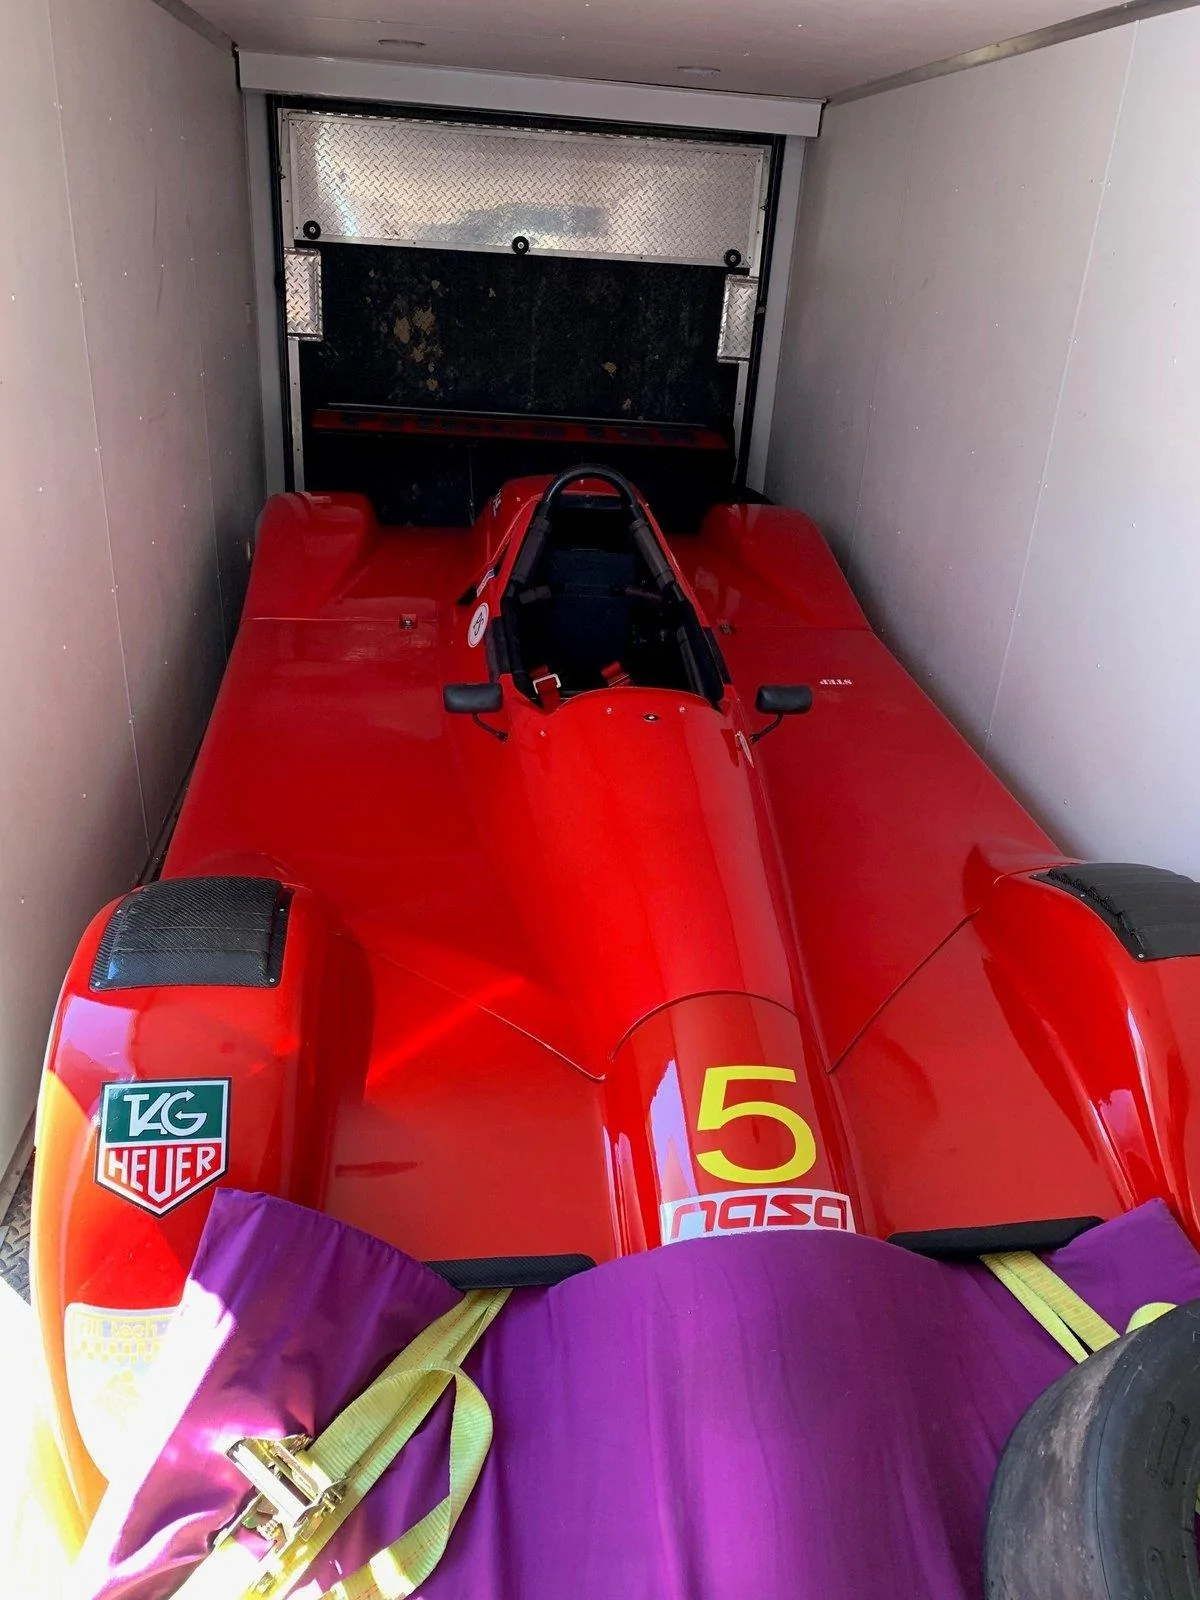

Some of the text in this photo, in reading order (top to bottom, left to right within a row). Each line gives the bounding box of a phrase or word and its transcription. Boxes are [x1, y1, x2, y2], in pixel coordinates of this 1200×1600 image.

[123, 1089, 208, 1137] TAG
[696, 1065, 817, 1184] 5
[107, 1146, 216, 1202] HEUER
